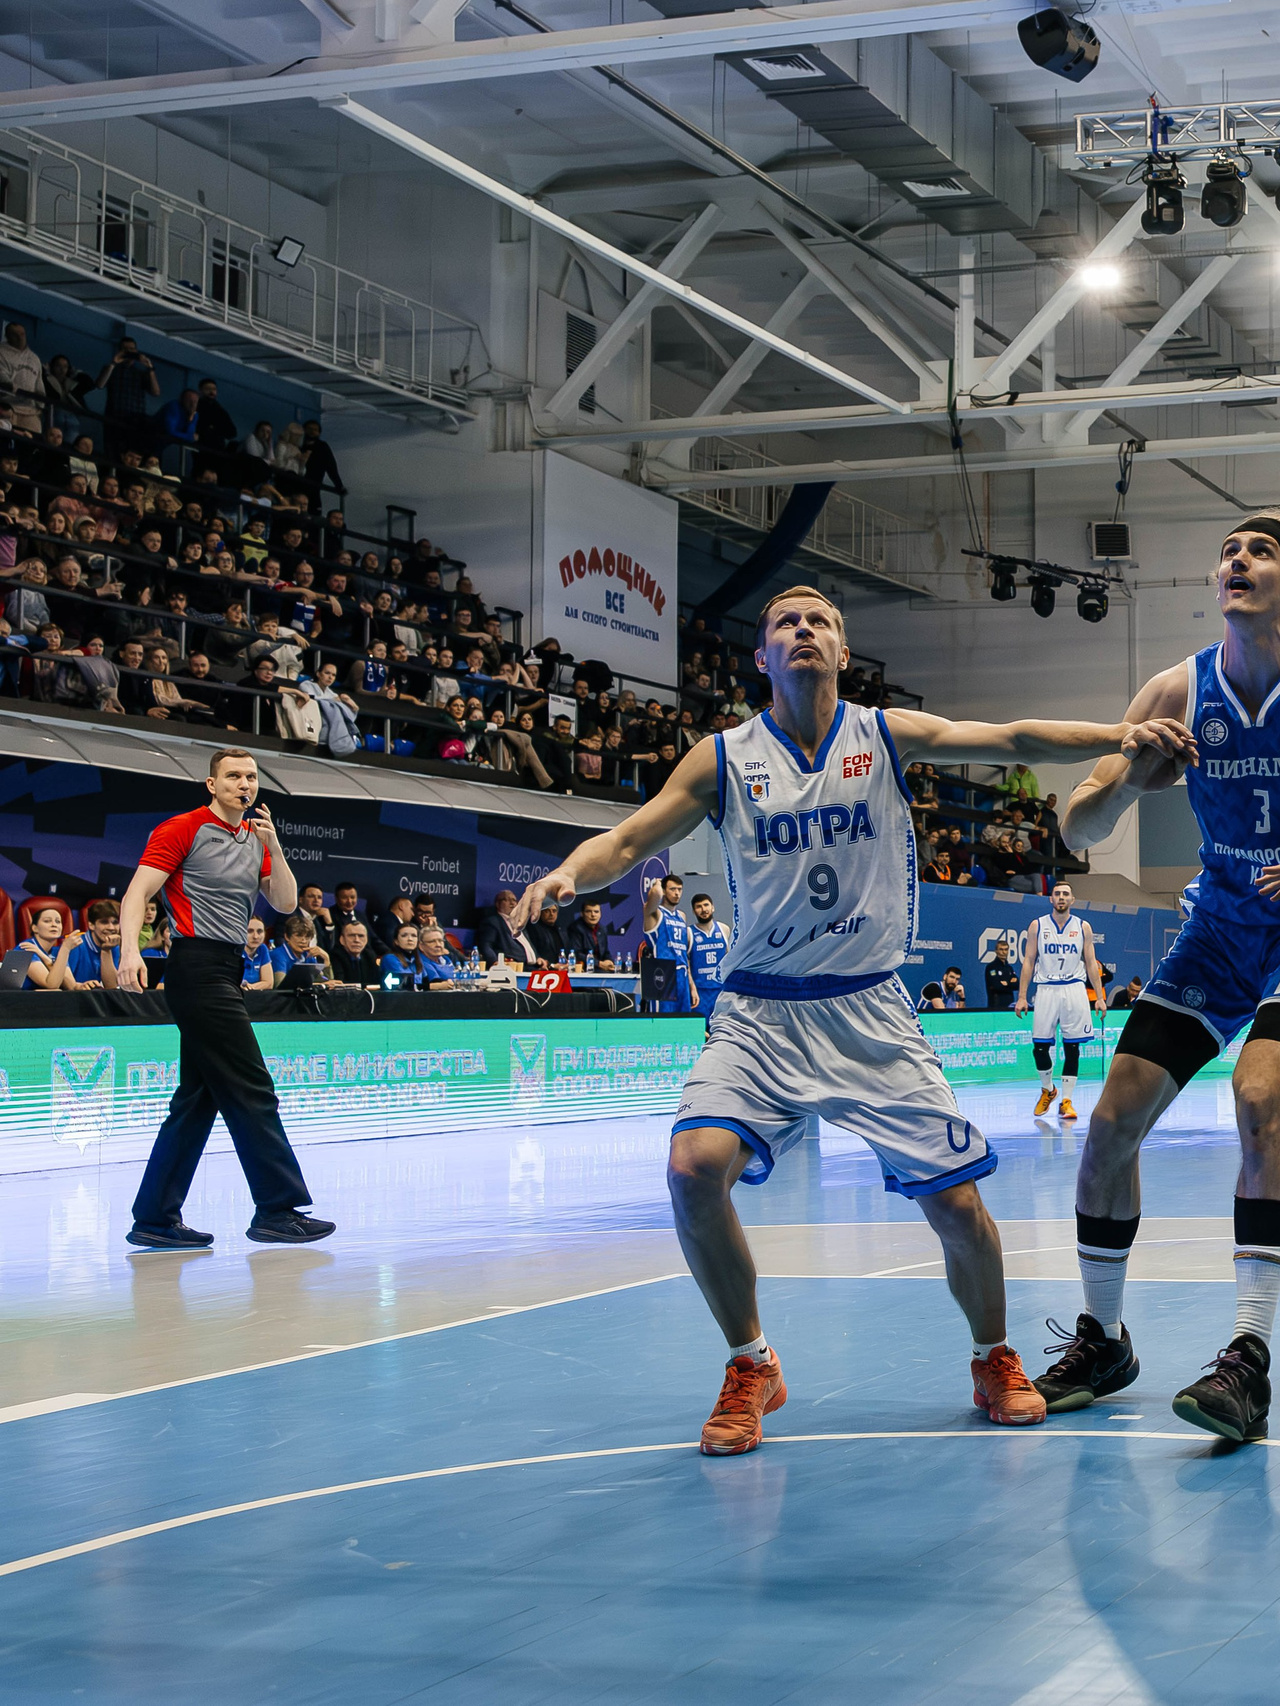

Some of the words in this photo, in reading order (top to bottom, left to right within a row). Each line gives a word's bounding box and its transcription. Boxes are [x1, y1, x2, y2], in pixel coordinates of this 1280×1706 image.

[559, 546, 666, 616] ПОМОЩНИК
[606, 590, 624, 614] ВСЕ
[565, 606, 578, 619] ДЛЯ
[582, 610, 607, 628] СУХОГО
[610, 619, 659, 642] СТРОИТЕЛЬСТВА
[843, 752, 873, 766] FON
[843, 764, 872, 779] BET
[1253, 789, 1271, 833] 3
[276, 818, 345, 839] Чемпионат
[754, 800, 876, 857] ЮГРА
[422, 856, 460, 874] Fonbet
[399, 877, 459, 895] Суперлига
[807, 863, 839, 910] 9
[674, 928, 682, 940] 21
[1044, 943, 1078, 954] ЮГРА
[1058, 958, 1065, 970] 7
